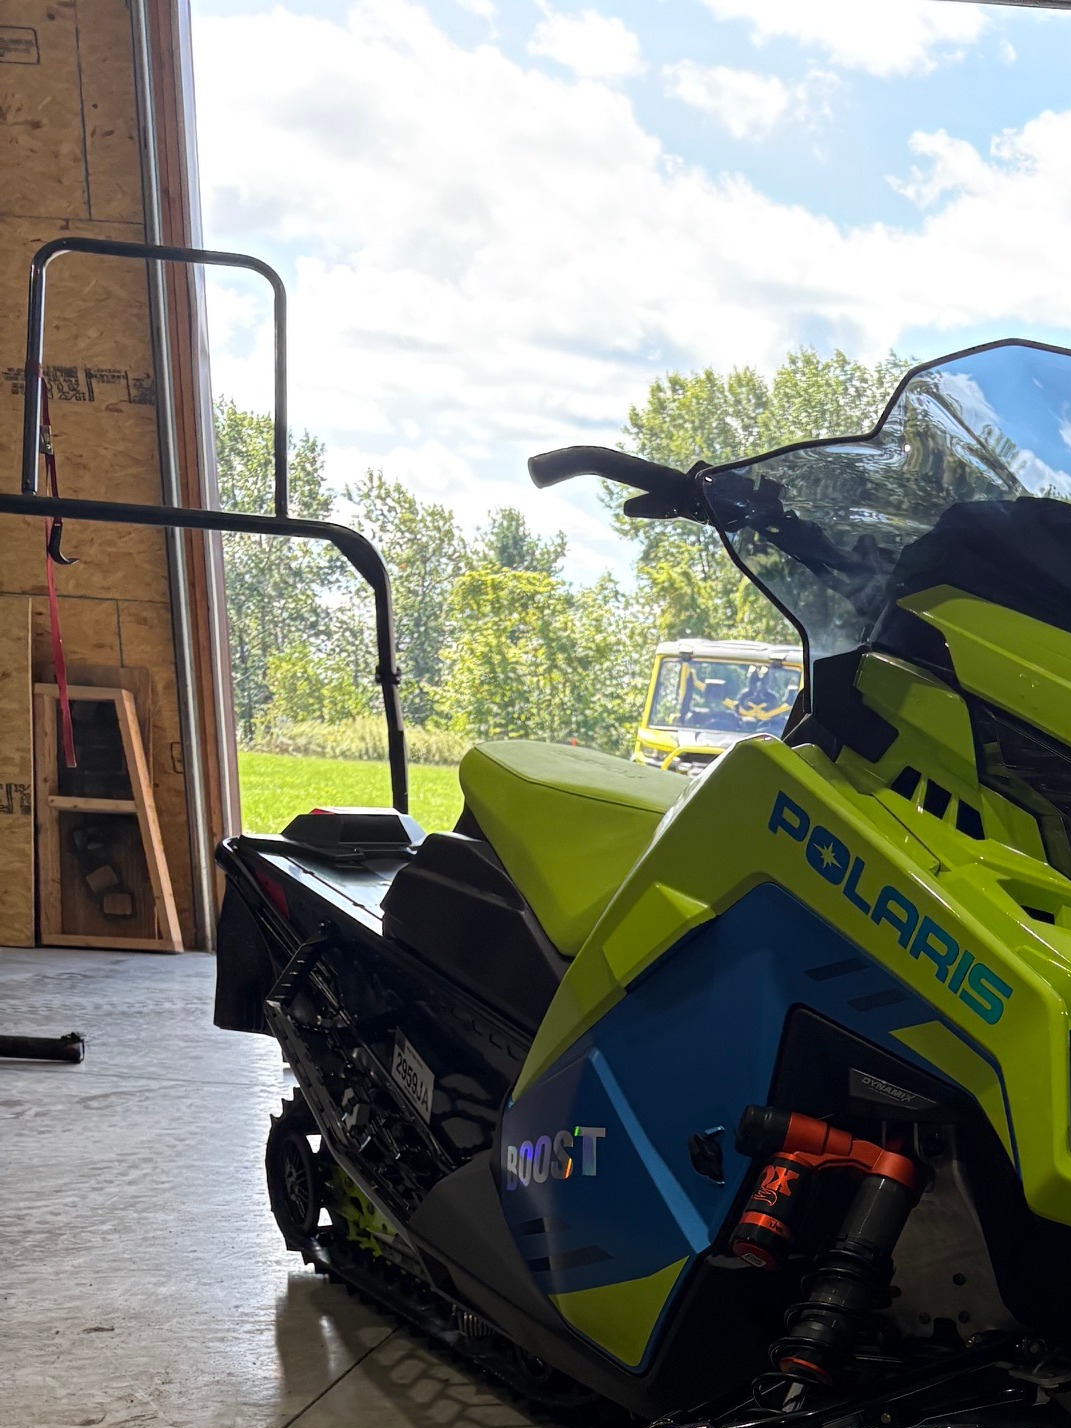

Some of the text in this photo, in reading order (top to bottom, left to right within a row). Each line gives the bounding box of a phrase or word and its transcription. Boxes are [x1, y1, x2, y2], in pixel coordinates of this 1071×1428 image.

[768, 790, 1014, 1026] POLARIS
[862, 1076, 916, 1103] DYNAMIX
[506, 1126, 606, 1191] BOOST
